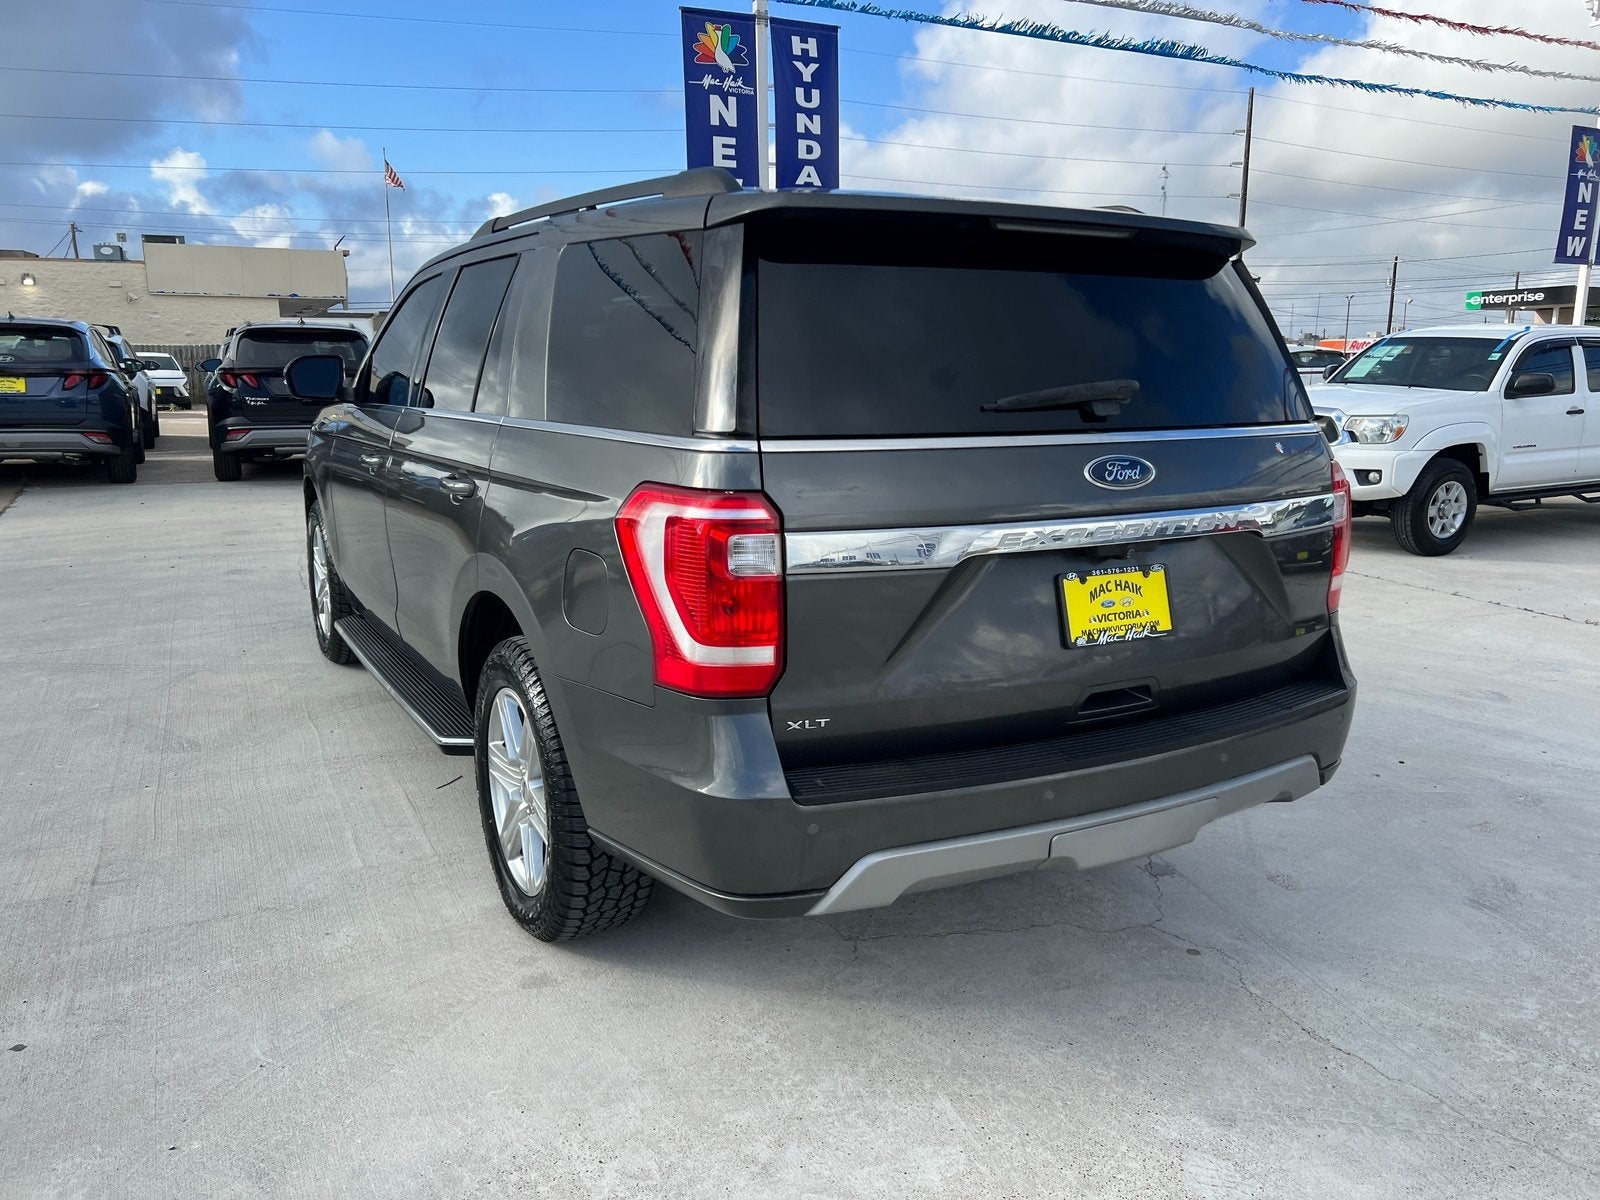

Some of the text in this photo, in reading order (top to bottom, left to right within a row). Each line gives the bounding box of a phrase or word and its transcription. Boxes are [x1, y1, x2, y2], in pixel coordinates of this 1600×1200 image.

[694, 74, 750, 92] Mac Haik
[728, 87, 755, 96] VICTORIA
[790, 35, 822, 187] HYUNDA
[710, 94, 743, 187] NE
[1566, 182, 1593, 257] NEW
[1467, 291, 1545, 306] enterprise
[1105, 461, 1141, 481] Ford
[997, 513, 1239, 549] EXPEDITION
[1091, 566, 1140, 576] 361-576-1221
[1089, 579, 1144, 604] MAC HAIK
[1096, 609, 1142, 623] VICTORIA
[1081, 620, 1160, 637] MACHAKVICTORIACOM
[1093, 625, 1160, 646] Mac Haik
[786, 718, 831, 731] XLT
